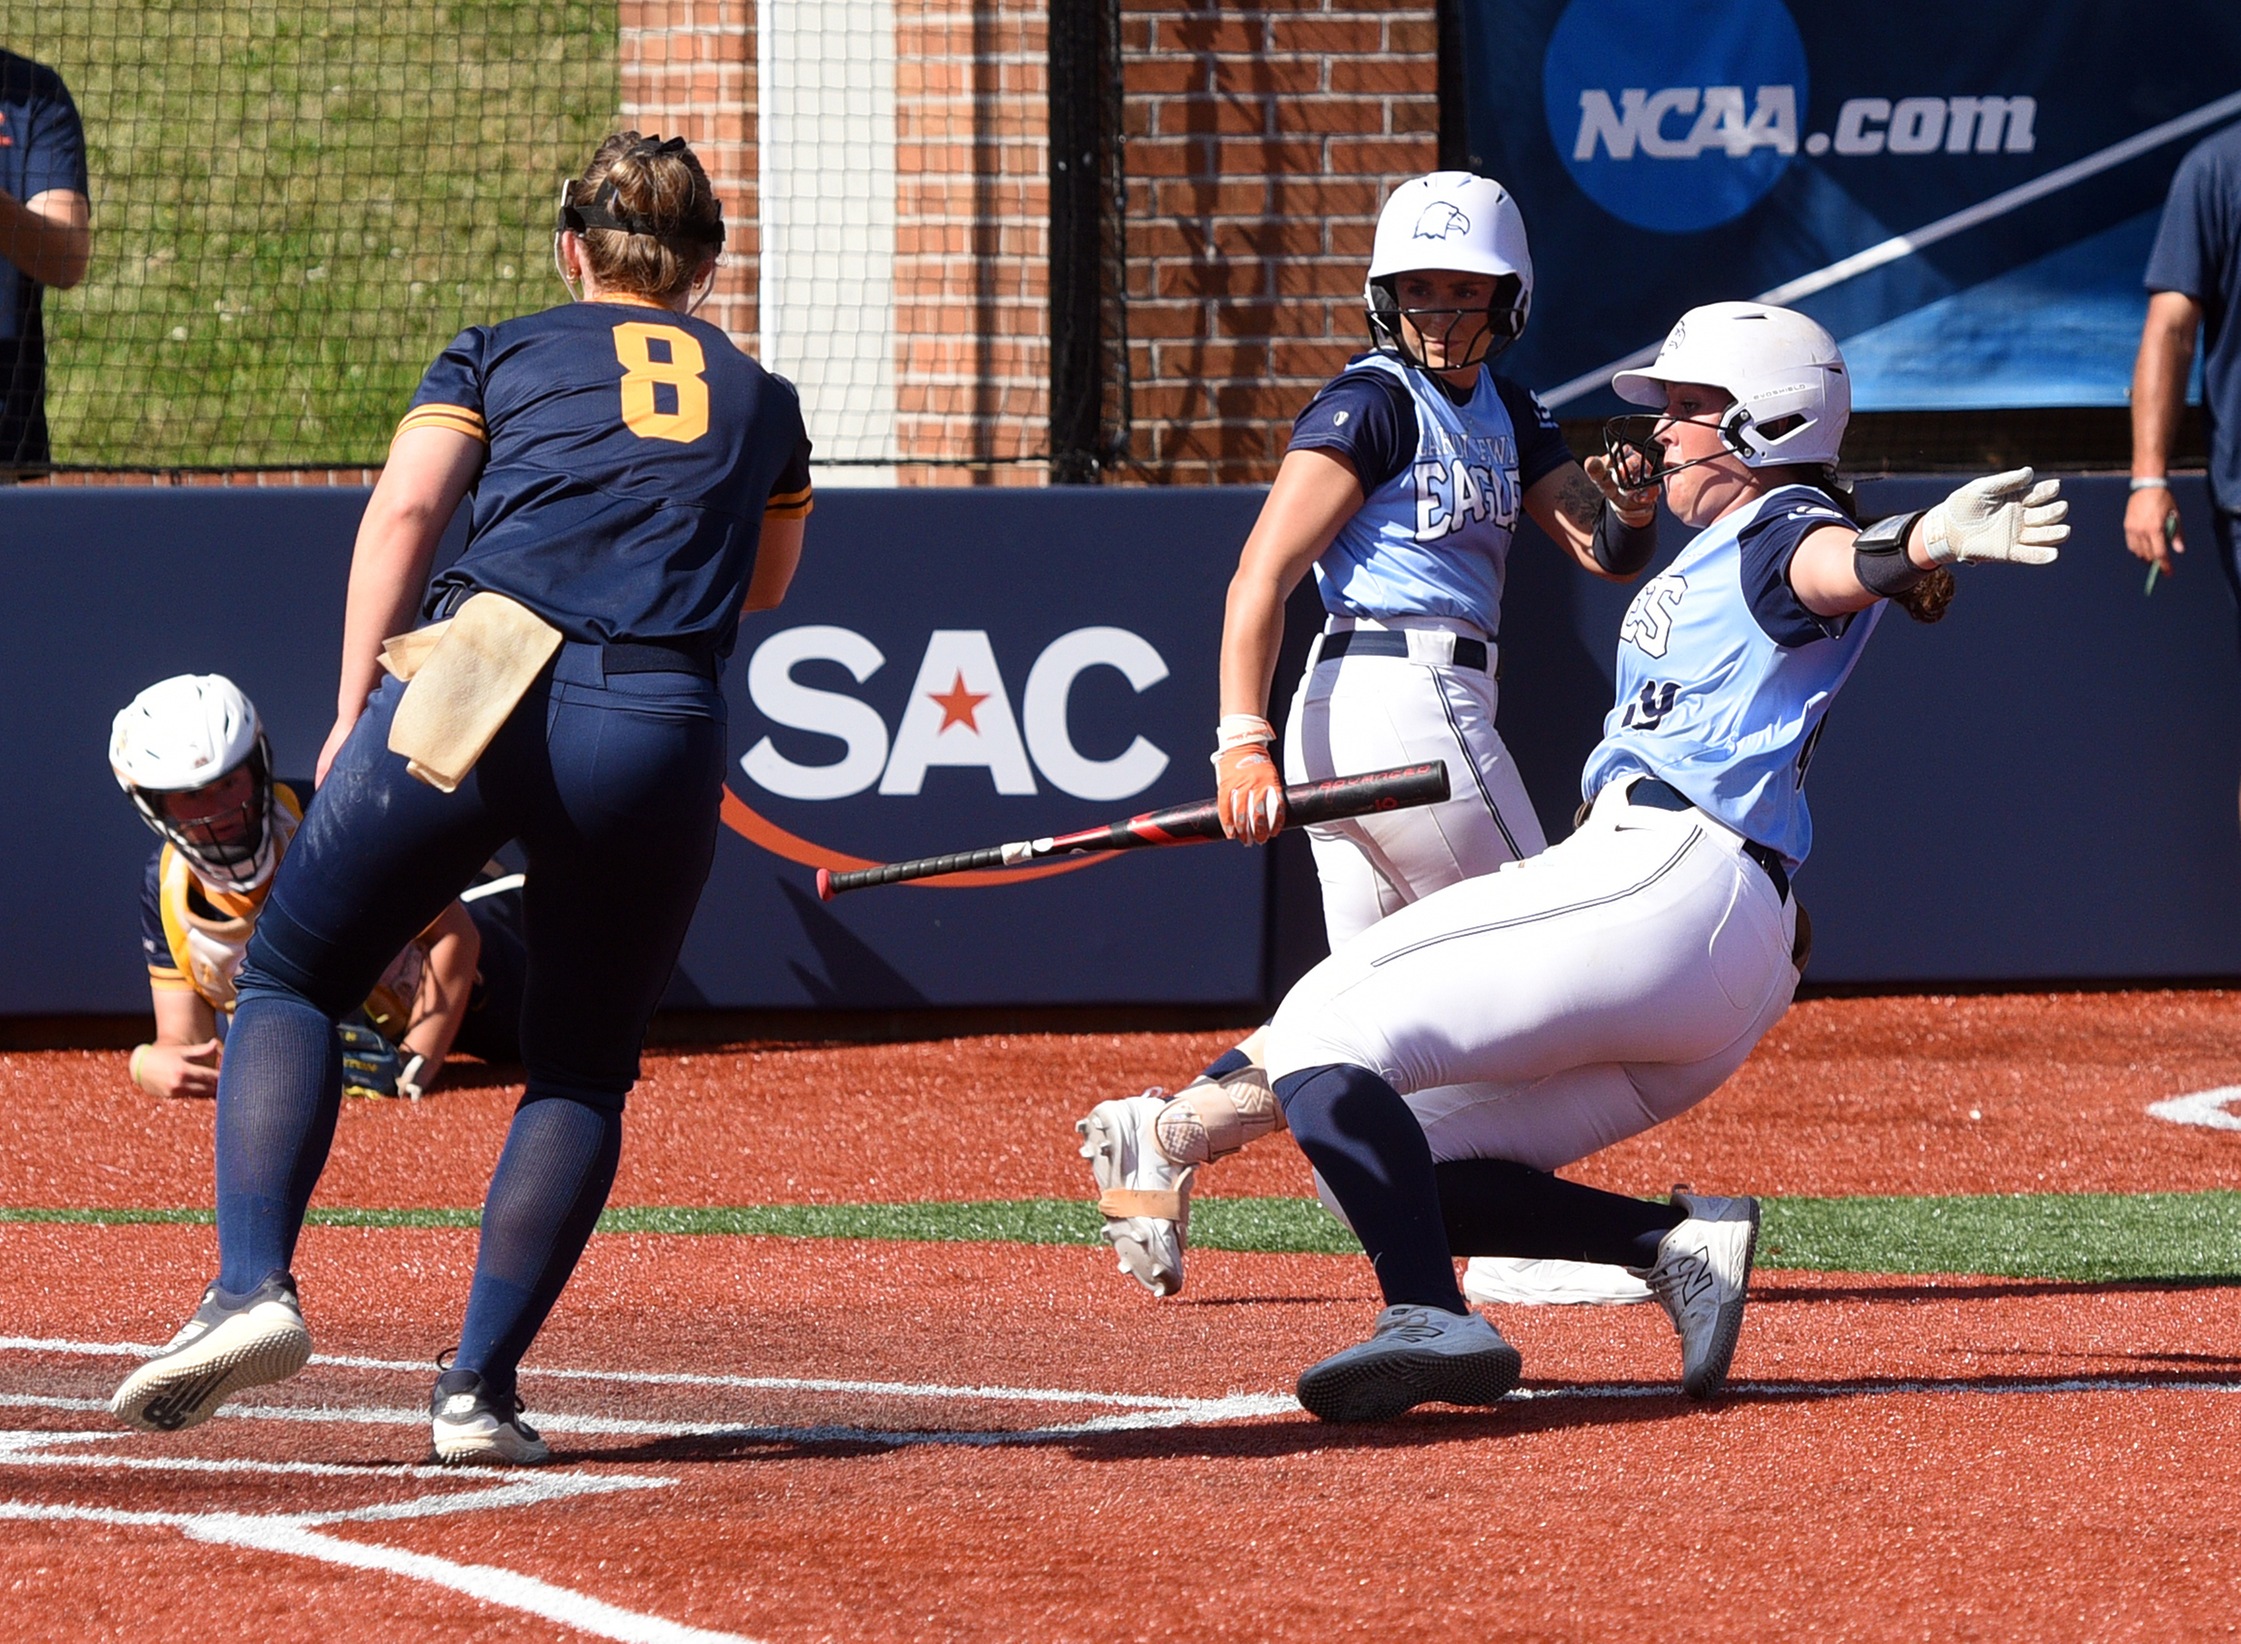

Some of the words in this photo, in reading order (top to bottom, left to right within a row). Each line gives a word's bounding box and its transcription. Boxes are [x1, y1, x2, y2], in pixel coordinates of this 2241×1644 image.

[1573, 83, 2037, 161] NCAA.com
[612, 321, 709, 443] 8
[739, 624, 1171, 801] SAC
